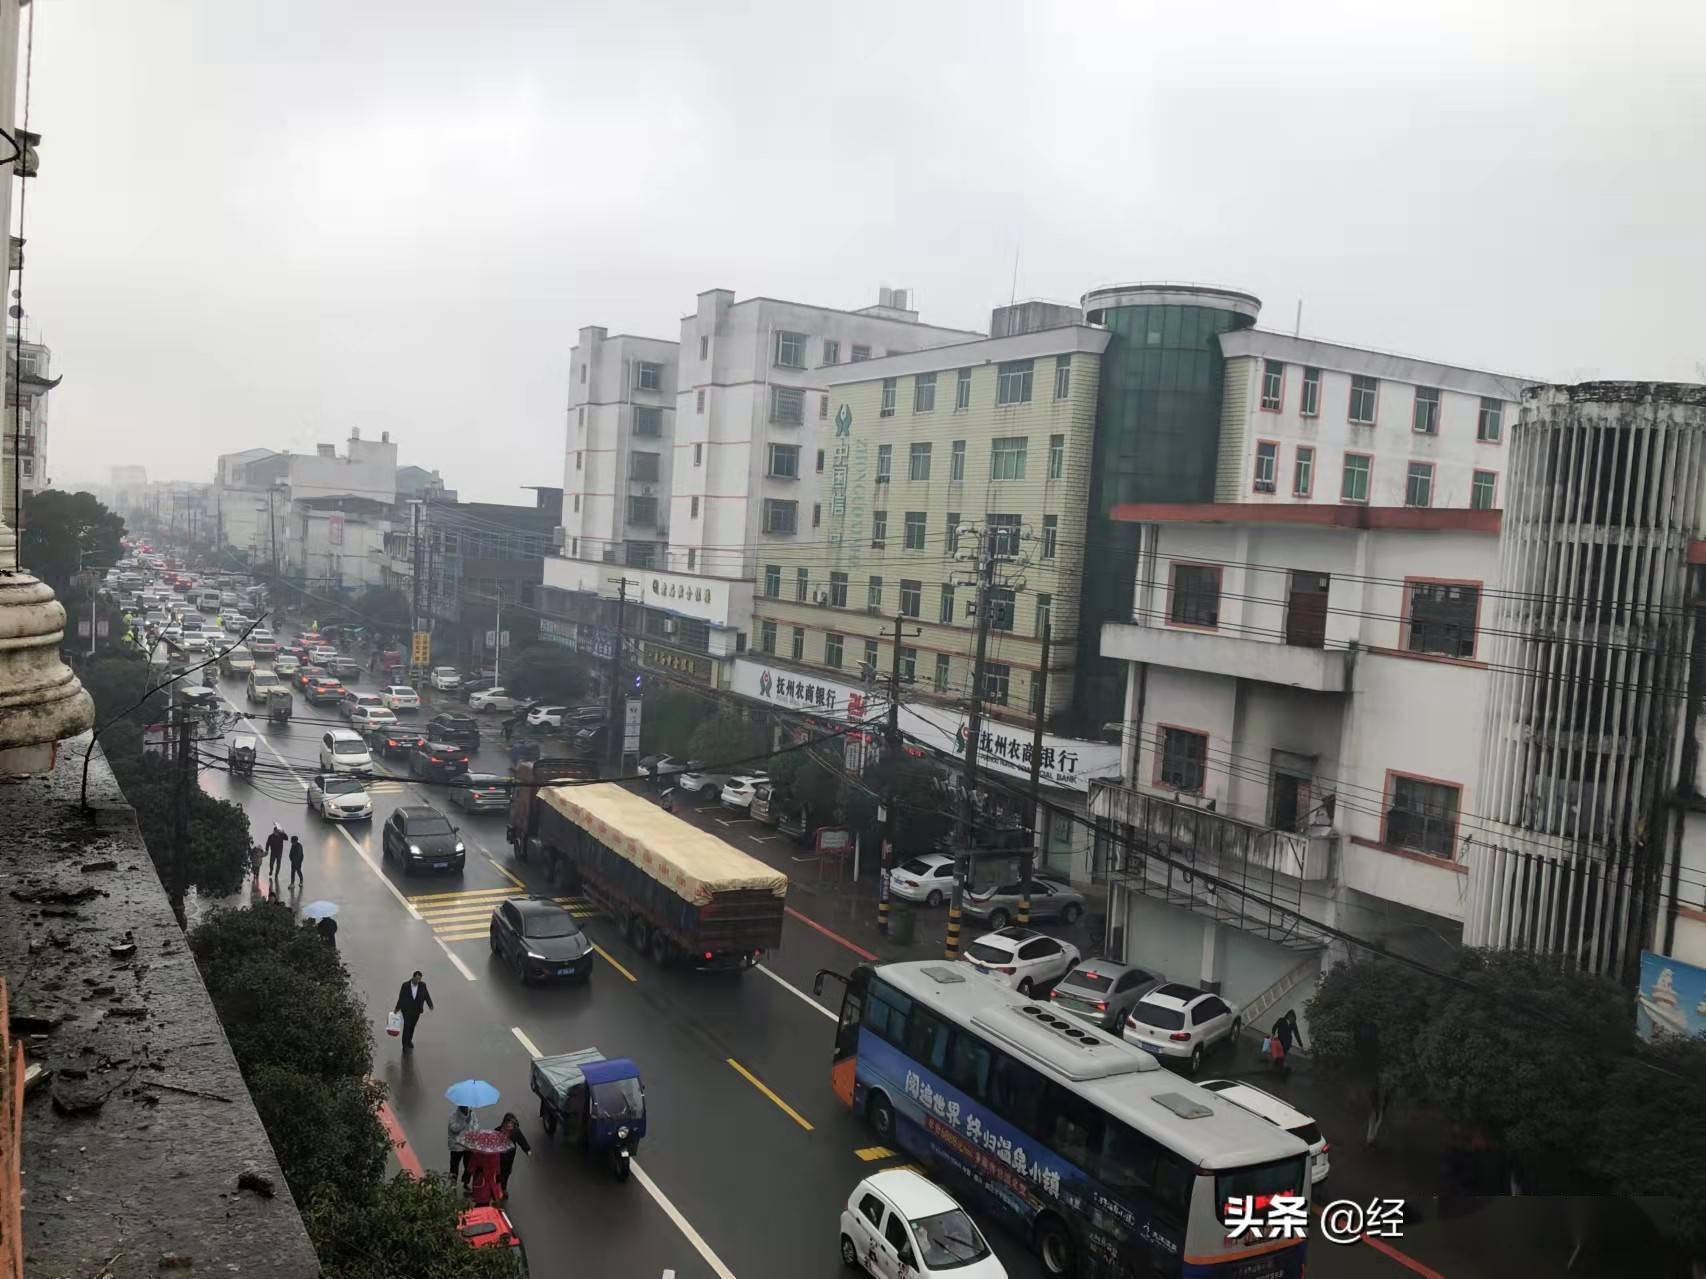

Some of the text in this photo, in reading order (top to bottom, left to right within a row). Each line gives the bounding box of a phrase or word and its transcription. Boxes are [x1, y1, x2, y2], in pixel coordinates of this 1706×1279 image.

[776, 676, 837, 709] 抚州农商银行
[979, 730, 1079, 774] 抚州农商银行
[905, 1069, 961, 1127] 阅遍世界
[966, 1113, 1061, 1200] 终归温泉小镇
